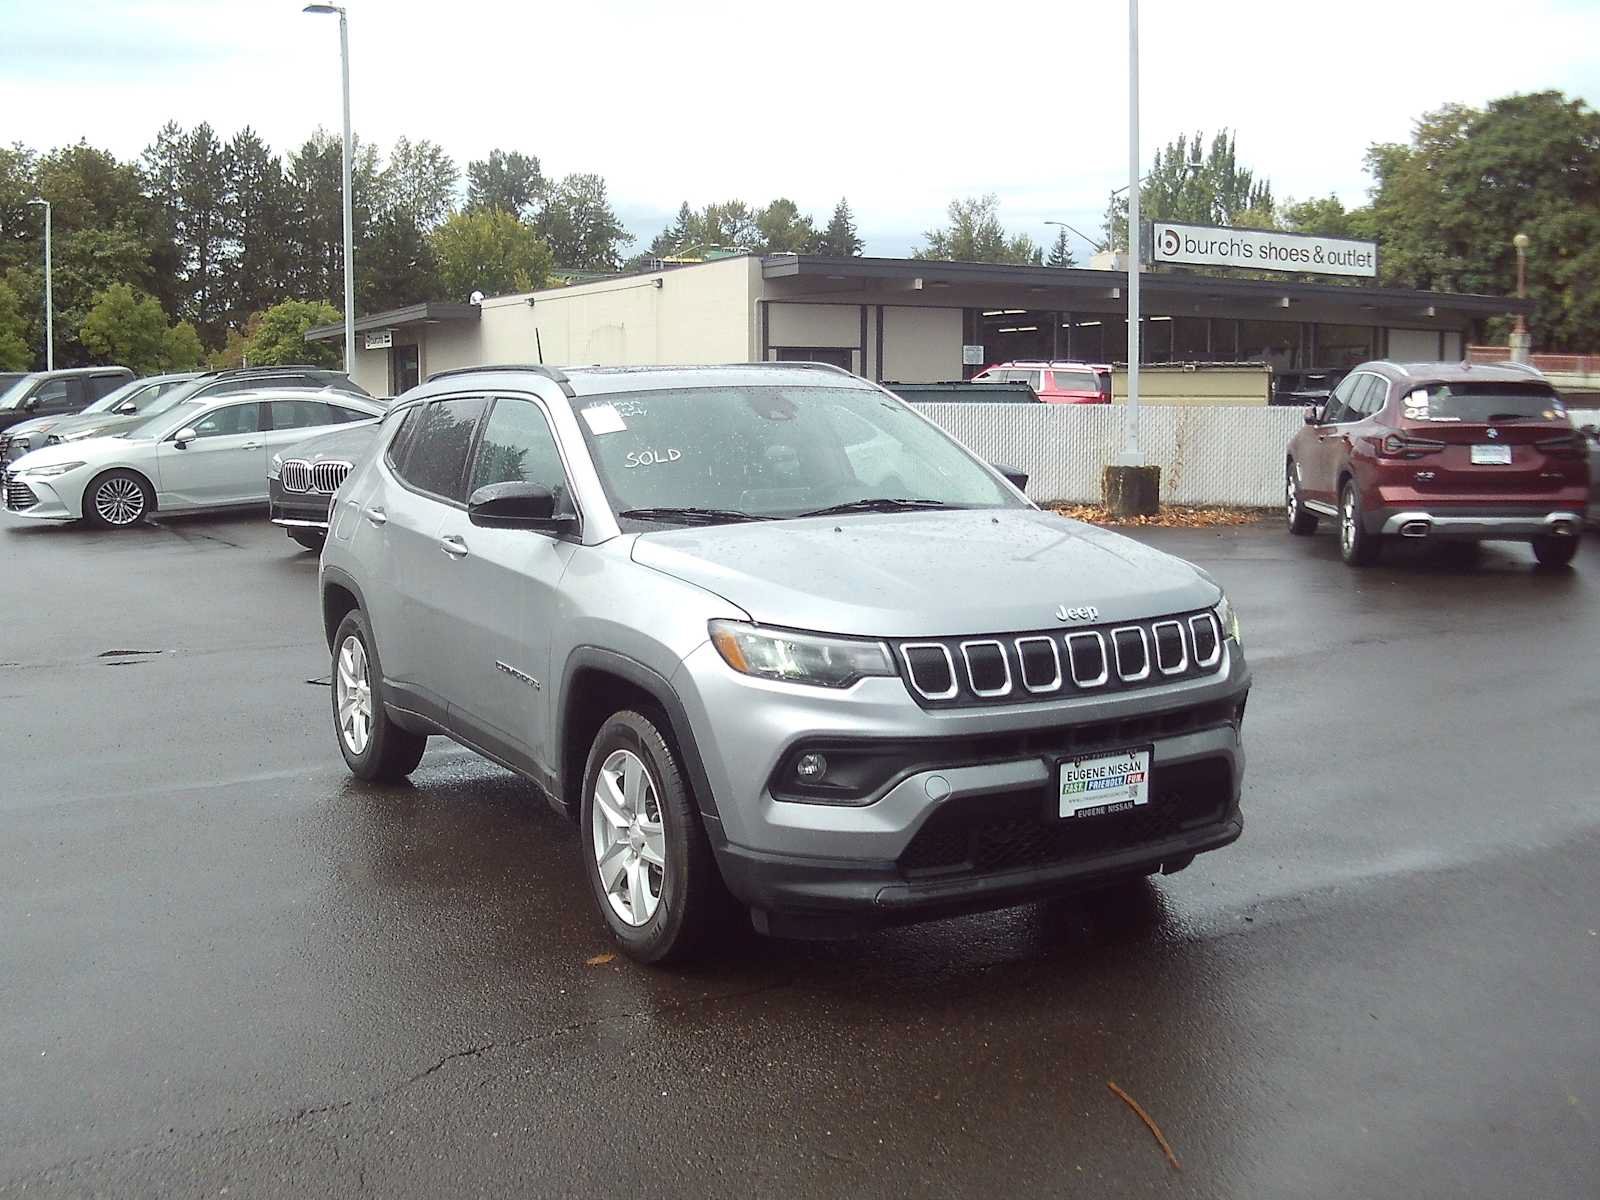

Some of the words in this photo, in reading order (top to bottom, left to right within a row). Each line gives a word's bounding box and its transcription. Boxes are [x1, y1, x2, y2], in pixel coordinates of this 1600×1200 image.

[1185, 234, 1253, 258] burch's
[1259, 241, 1310, 263] shoes
[1313, 245, 1324, 264] &
[1327, 249, 1372, 268] outlet
[624, 448, 681, 468] SOLD
[1055, 604, 1098, 622] Jeep
[1067, 766, 1106, 782] EUGENE
[1108, 761, 1141, 775] NISSAN
[1078, 806, 1106, 819] EUGENE
[1107, 801, 1134, 813] NISSAN
